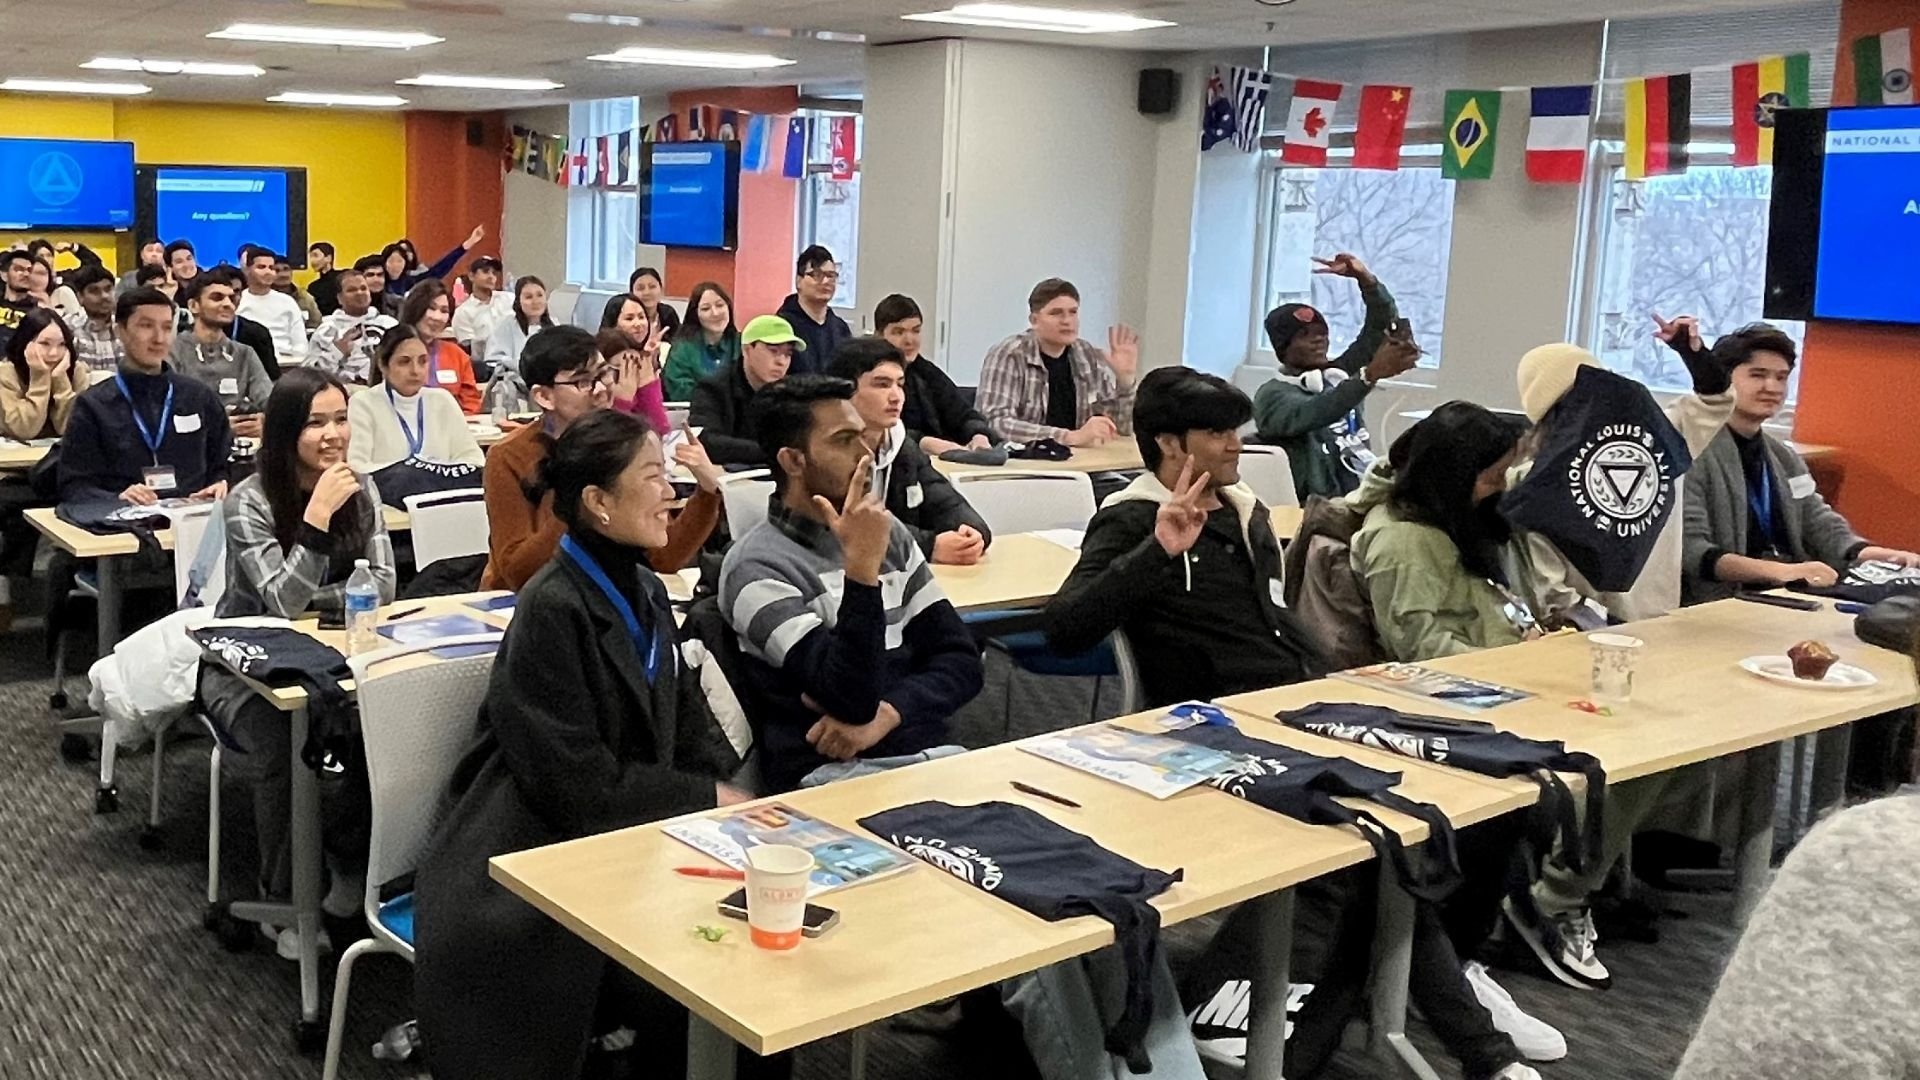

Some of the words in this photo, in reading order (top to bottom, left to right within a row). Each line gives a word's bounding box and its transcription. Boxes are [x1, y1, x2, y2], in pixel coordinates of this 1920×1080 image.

[1832, 136, 1911, 146] NATIONAL
[1903, 199, 1920, 215] A
[1596, 424, 1641, 441] LOUIS
[1568, 441, 1596, 518] NATIONAL
[1616, 451, 1671, 537] UNIVERSITY
